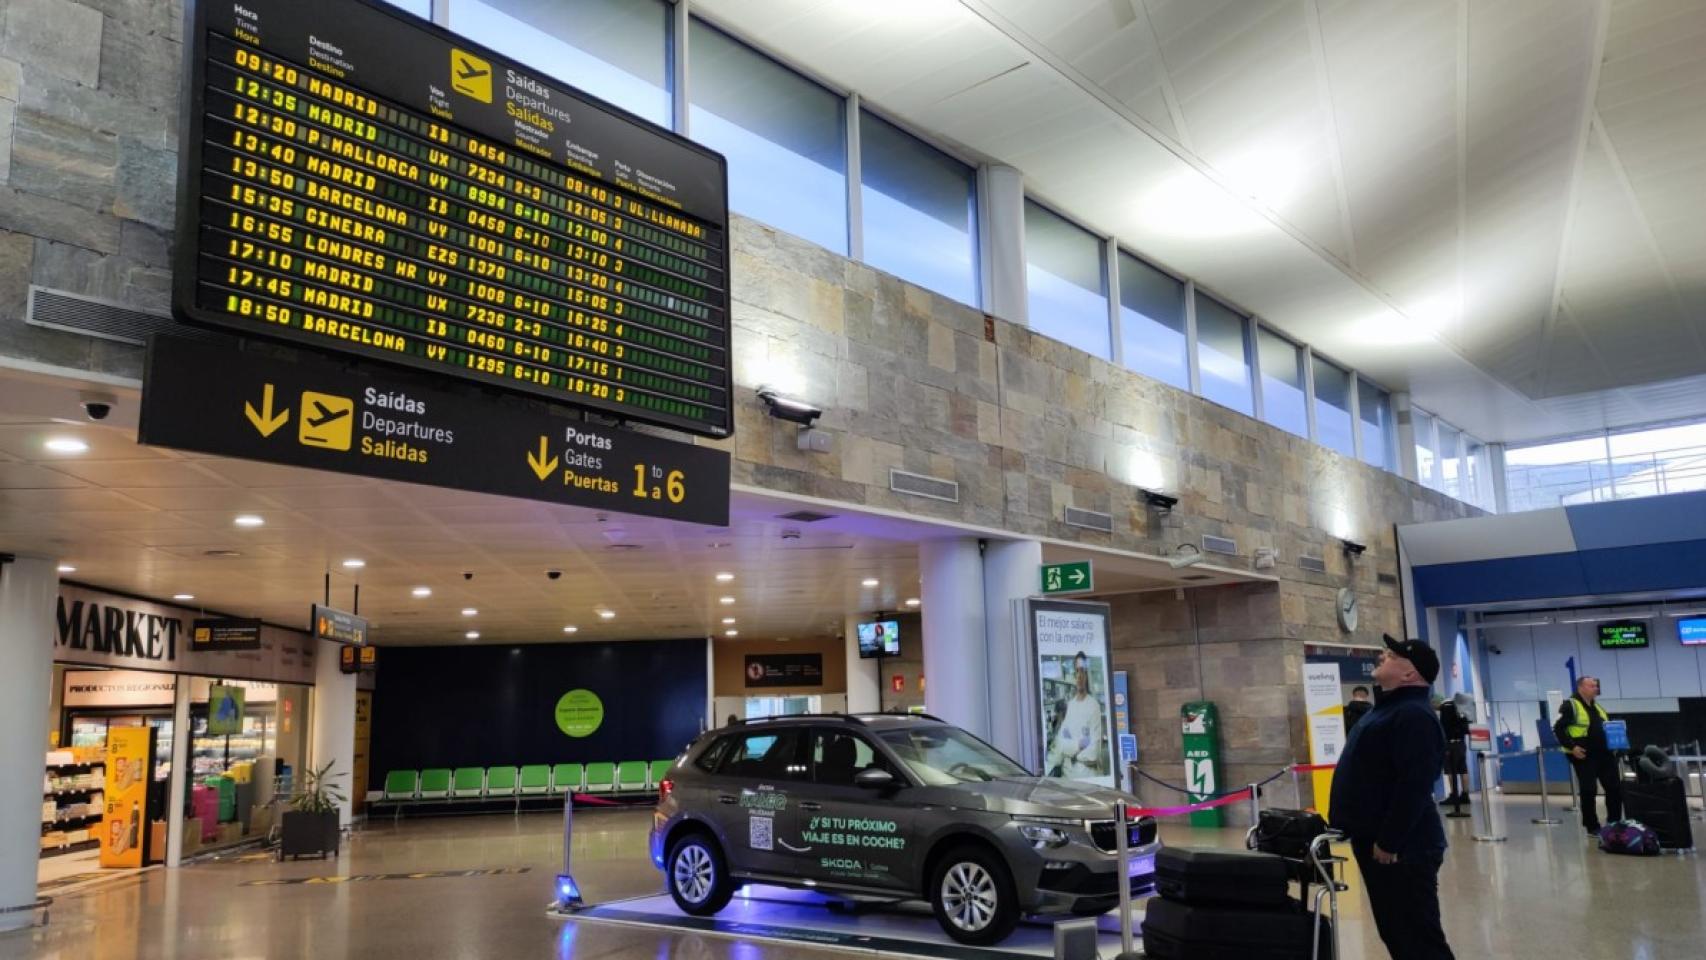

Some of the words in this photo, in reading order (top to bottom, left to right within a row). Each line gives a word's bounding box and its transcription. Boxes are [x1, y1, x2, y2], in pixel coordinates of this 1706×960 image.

[234, 4, 258, 21] Hora
[236, 17, 258, 33] Time
[235, 27, 260, 46] Hora
[309, 35, 343, 56] Destino
[309, 46, 354, 72] Destination
[309, 57, 345, 78] Destino
[506, 86, 571, 123] Departures
[506, 101, 554, 133] Salidas
[235, 49, 297, 85] 09:20
[310, 78, 377, 115] MADRID
[429, 124, 449, 143] IB
[468, 139, 506, 164] 0454
[614, 195, 622, 209] 3
[515, 120, 549, 139] Mostrador
[235, 77, 297, 111] 12:35
[309, 103, 377, 140] MADRID
[429, 149, 449, 167] UX
[468, 163, 506, 188] 7234
[515, 180, 541, 200] 2-3
[614, 217, 622, 230] 3
[516, 138, 552, 158] Mostrador
[234, 103, 296, 137] 12:30
[308, 129, 419, 180] P.MALLORCA
[429, 172, 448, 190] VY
[515, 202, 550, 226] 6-10
[566, 220, 607, 246] 12:00
[614, 238, 622, 251] 4
[233, 131, 295, 164] 13:40
[307, 156, 376, 191] MADRID
[429, 197, 448, 215] IB
[468, 210, 506, 234] 0458
[515, 226, 550, 248] 6-10
[566, 243, 607, 267] 13:10
[614, 259, 623, 273] 3
[233, 156, 294, 189] 13:50
[307, 182, 407, 226] BARCELONA
[428, 221, 447, 239] VY
[468, 234, 504, 257] 1001
[515, 249, 550, 271] 6-10
[566, 266, 607, 289] 13:20
[615, 281, 623, 295] 4
[231, 184, 293, 216] 15:35
[306, 208, 386, 244] GINEBRA
[428, 245, 458, 266] EZS
[468, 257, 506, 280] 1370
[567, 287, 608, 310] 15:05
[615, 302, 623, 315] 3
[230, 212, 293, 243] 16:55
[305, 234, 385, 269] LONDRES
[395, 260, 416, 280] HR
[428, 270, 447, 287] VY
[468, 282, 506, 304] 1008
[515, 295, 550, 316] 6-10
[567, 310, 608, 333] 16:25
[615, 324, 623, 337] 4
[229, 239, 292, 270] 17:10
[304, 261, 374, 293] MADRID
[427, 294, 447, 312] UX
[467, 305, 506, 327] 7236
[514, 318, 541, 337] 2-3
[567, 332, 608, 354] 16:40
[615, 345, 624, 359] 3
[228, 267, 291, 296] 17:45
[304, 287, 373, 318] MADRID
[427, 319, 447, 337] IB
[467, 329, 506, 351] 0460
[514, 341, 550, 362] 6-10
[567, 355, 609, 376] 17:15
[616, 367, 623, 380] 1
[303, 314, 405, 351] BARCELONA
[427, 344, 446, 360] VY
[468, 354, 506, 375] 1295
[514, 365, 550, 385] 6-10
[616, 388, 624, 402] 3
[364, 387, 426, 415] Saídas
[362, 411, 454, 444] Departures
[566, 427, 612, 450] Portas
[361, 436, 428, 464] Salidas
[565, 449, 603, 470] Gates
[564, 470, 619, 494] Puertas
[632, 464, 647, 498] 1
[652, 464, 663, 479] to
[652, 485, 662, 499] a
[666, 469, 686, 504] 6
[55, 596, 183, 661] MARKET
[1048, 618, 1070, 631] mejor
[1186, 750, 1209, 758] AED
[822, 816, 832, 828] SI
[833, 817, 846, 829] TU
[848, 816, 897, 833] PRÓXIMO
[802, 831, 830, 844] VIAJE
[832, 832, 845, 844] ES
[847, 833, 860, 845] EN
[862, 835, 905, 849] COCHE?
